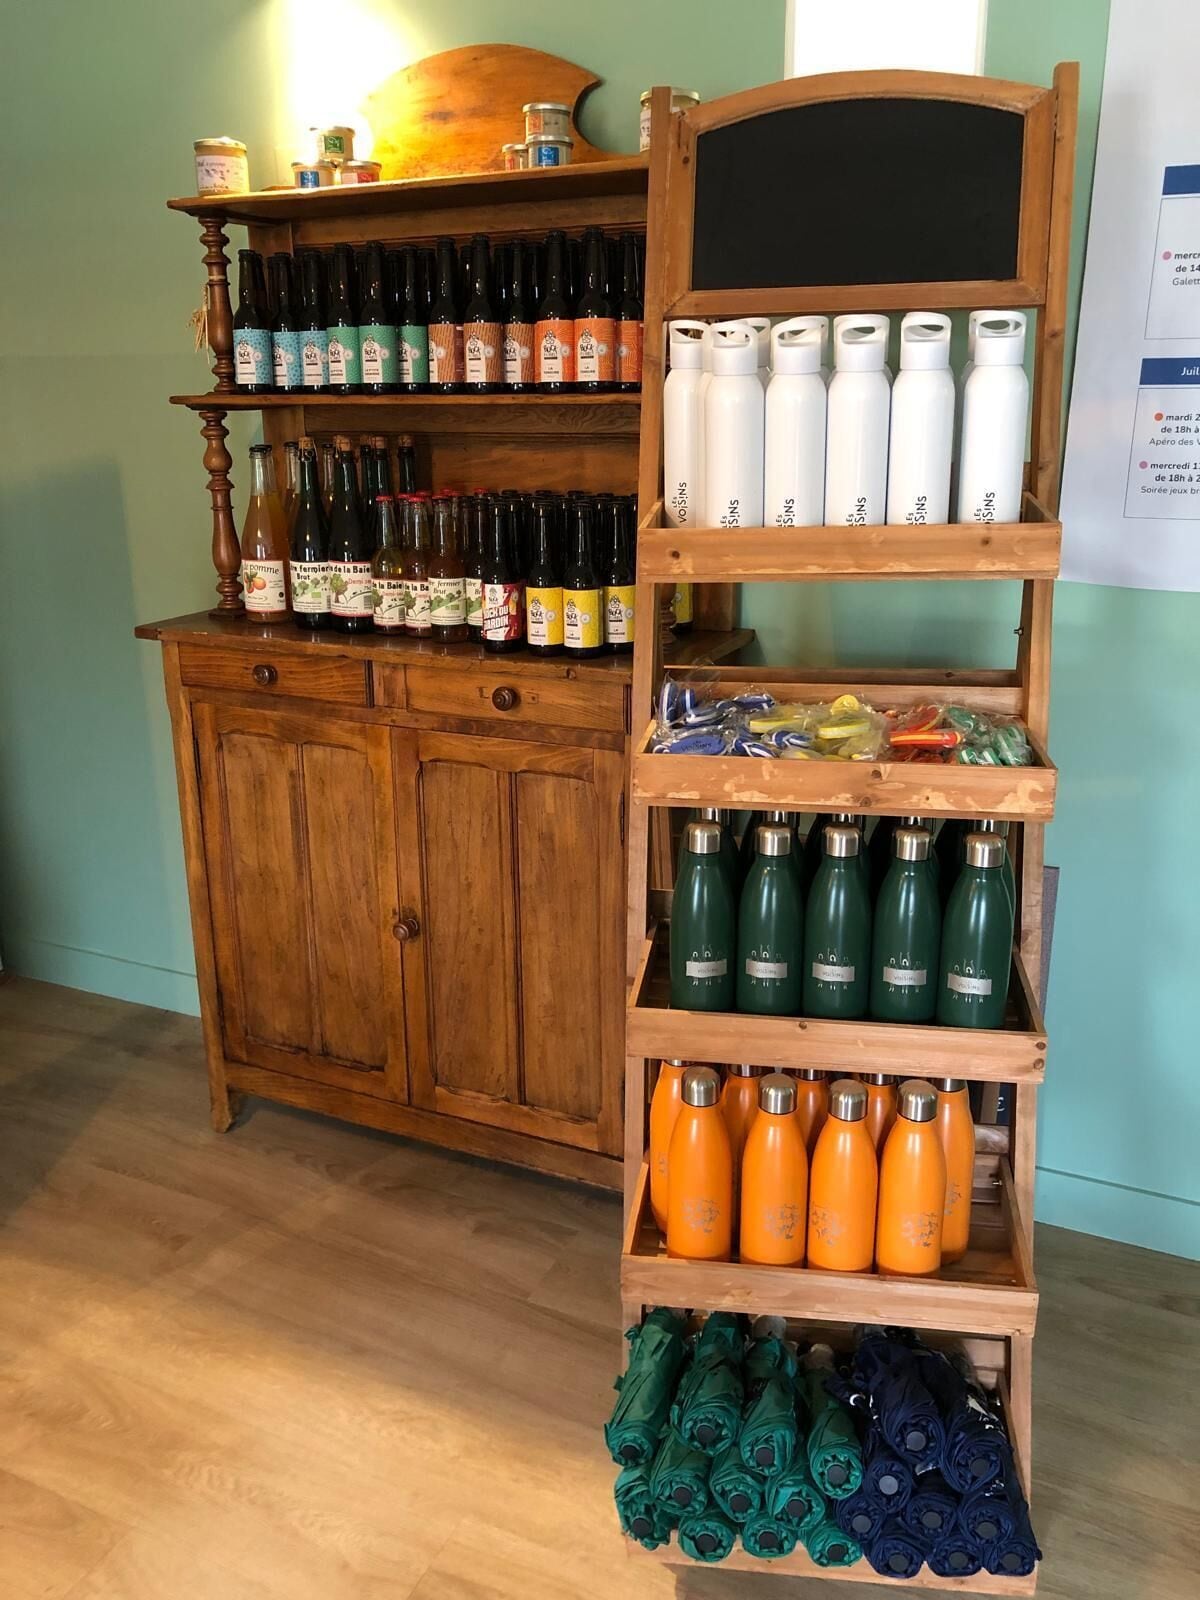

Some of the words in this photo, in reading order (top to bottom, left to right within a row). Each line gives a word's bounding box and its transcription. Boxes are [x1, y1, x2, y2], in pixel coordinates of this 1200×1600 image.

[1175, 264, 1187, 273] de
[1181, 366, 1200, 376] Juil
[1166, 413, 1193, 421] mardi
[1160, 426, 1172, 434] de
[1175, 426, 1191, 434] 18h
[1194, 425, 1200, 434] à
[1149, 437, 1176, 447] Apéro
[1178, 438, 1194, 446] des
[1150, 462, 1190, 470] mercredi
[1155, 474, 1166, 482] de
[1169, 474, 1185, 482] 18h
[1187, 474, 1193, 482] à
[1141, 486, 1168, 494] Soirée
[1170, 487, 1187, 495] jeux
[334, 564, 342, 573] de
[343, 564, 351, 574] la
[352, 563, 370, 574] Baie
[378, 580, 384, 589] la
[387, 580, 403, 590] Baie
